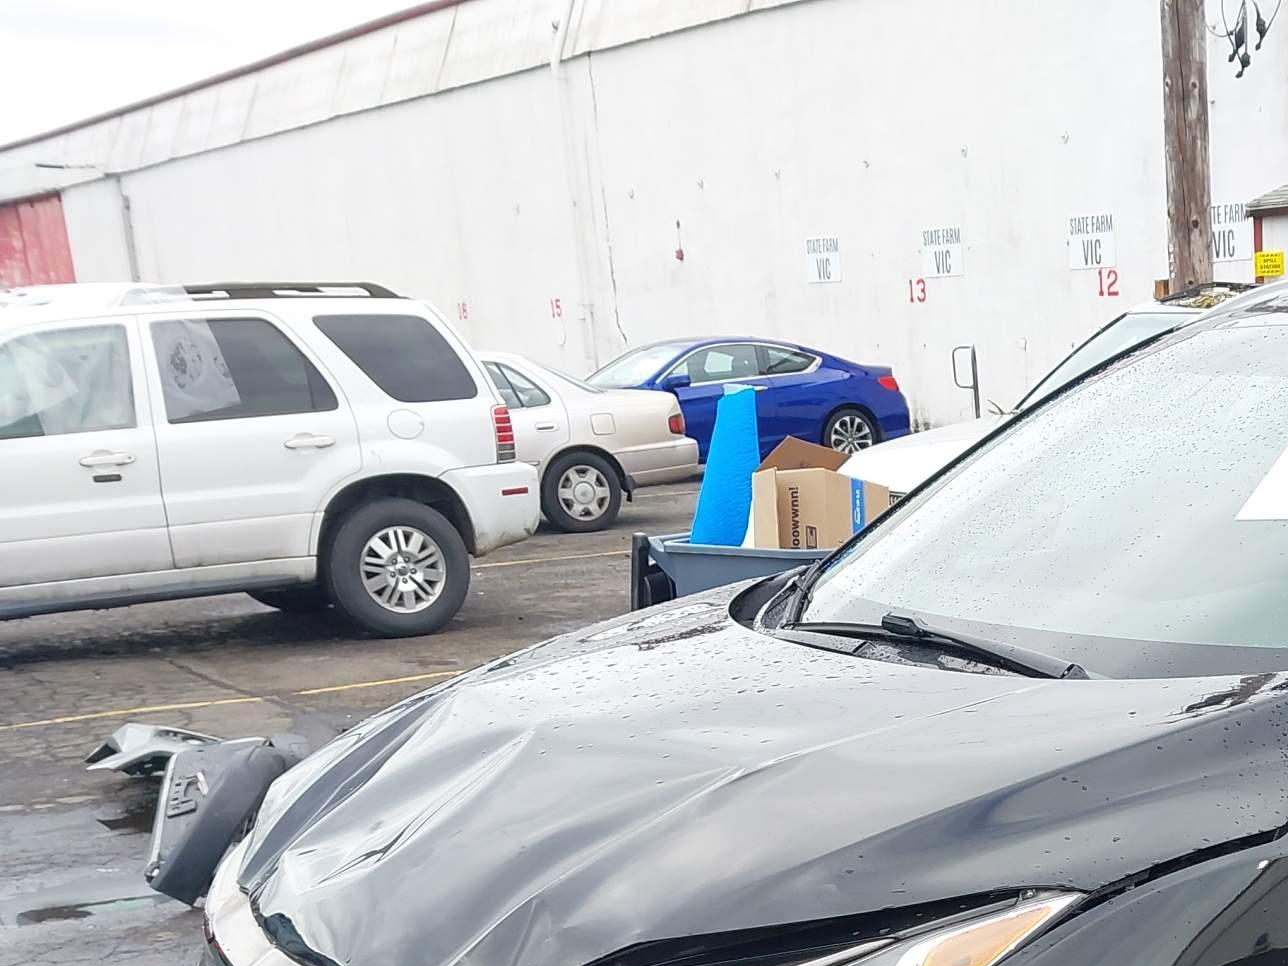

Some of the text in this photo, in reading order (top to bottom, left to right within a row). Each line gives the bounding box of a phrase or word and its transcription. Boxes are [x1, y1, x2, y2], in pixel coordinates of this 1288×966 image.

[1069, 213, 1113, 236] STATE FARM
[806, 238, 839, 254] STATE FARM
[922, 227, 961, 247] STATE FARM
[1212, 229, 1235, 259] VIC
[934, 250, 952, 274] VIC
[1082, 239, 1102, 266] VIC
[816, 258, 831, 281] VIC
[908, 278, 927, 303] 13
[1098, 269, 1119, 296] 12
[550, 298, 562, 319] 15
